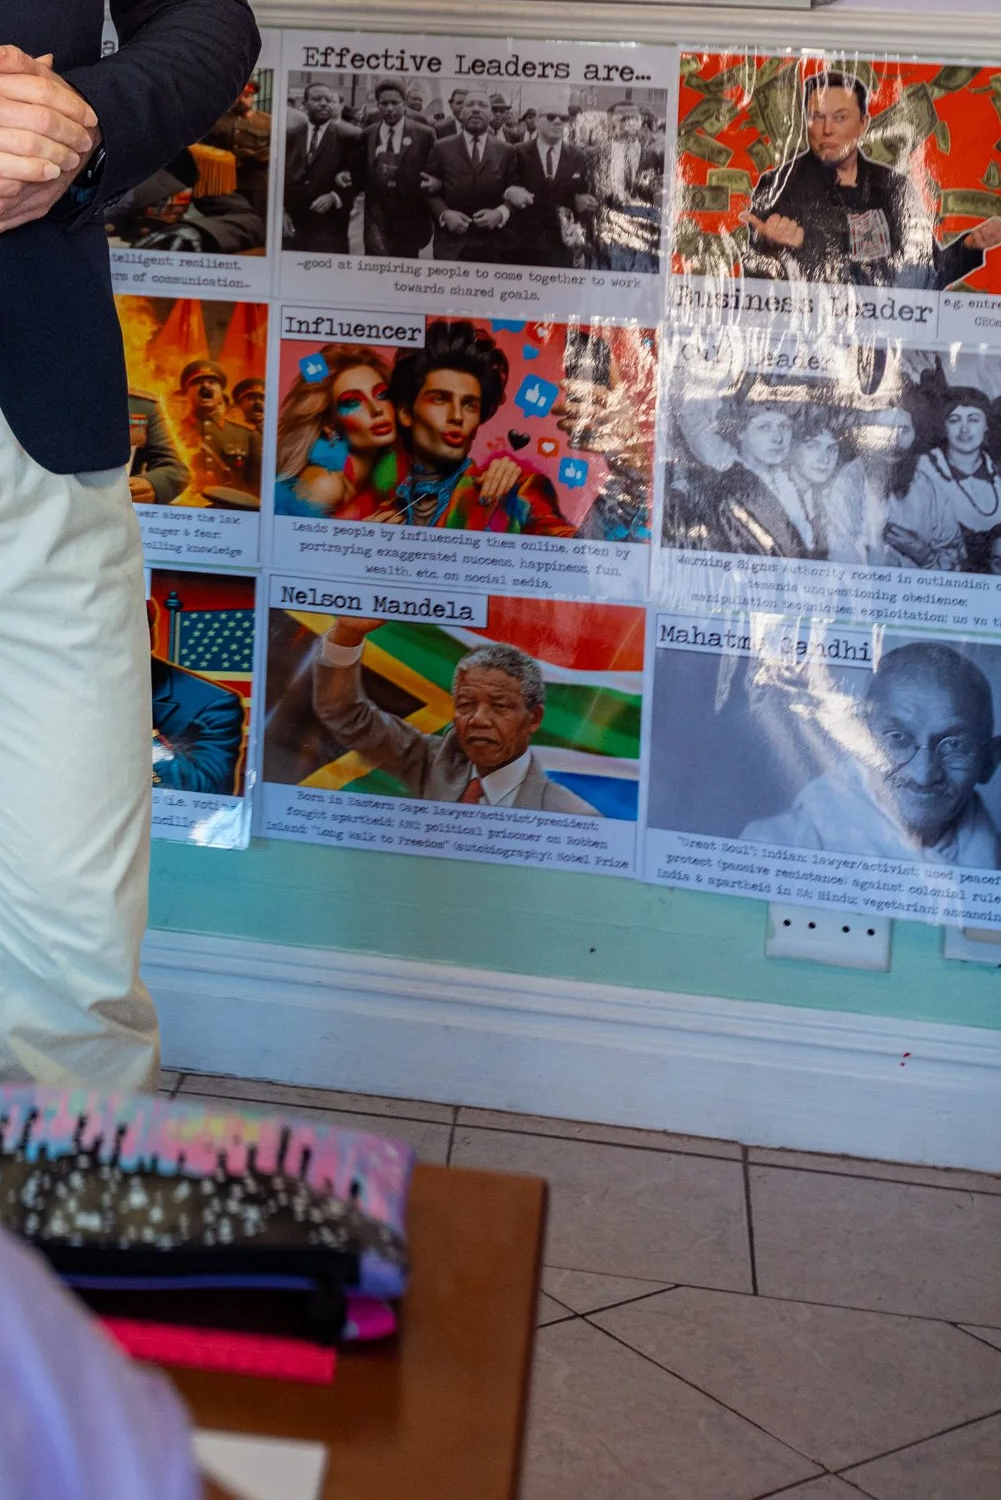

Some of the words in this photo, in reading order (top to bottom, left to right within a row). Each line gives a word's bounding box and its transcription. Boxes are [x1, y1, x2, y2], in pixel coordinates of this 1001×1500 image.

[302, 46, 443, 73] Effective
[454, 54, 571, 79] Leaders
[132, 270, 147, 282] of
[337, 259, 353, 270] at
[357, 260, 422, 278] inspiring
[427, 266, 471, 279] people
[475, 268, 489, 279] to
[493, 270, 523, 282] come
[528, 271, 586, 286] together
[591, 276, 605, 287] to
[610, 277, 642, 289] work
[393, 280, 445, 295] towards
[449, 284, 495, 298] shared
[825, 295, 934, 324] Leader
[284, 315, 423, 343] Influencer
[163, 511, 193, 522] above
[196, 513, 216, 523] the
[147, 527, 180, 539] anger
[291, 521, 329, 533] Leads
[332, 525, 377, 538] people
[379, 528, 396, 542] by
[400, 528, 482, 549] influencing
[486, 536, 516, 549] them
[572, 543, 610, 557] often
[614, 548, 631, 561] by
[299, 540, 372, 558] portraying
[377, 546, 458, 563] exaggerated
[443, 571, 460, 582] on
[463, 572, 507, 585] social
[851, 569, 892, 583] rooted
[897, 573, 912, 585] in
[916, 574, 991, 591] outlandish
[280, 585, 364, 612] Nelson
[373, 595, 476, 622] Mandela
[665, 852, 714, 868] protest
[851, 878, 905, 893] against
[908, 885, 966, 901] colonial
[707, 876, 772, 893] apartheid
[776, 885, 792, 896] in
